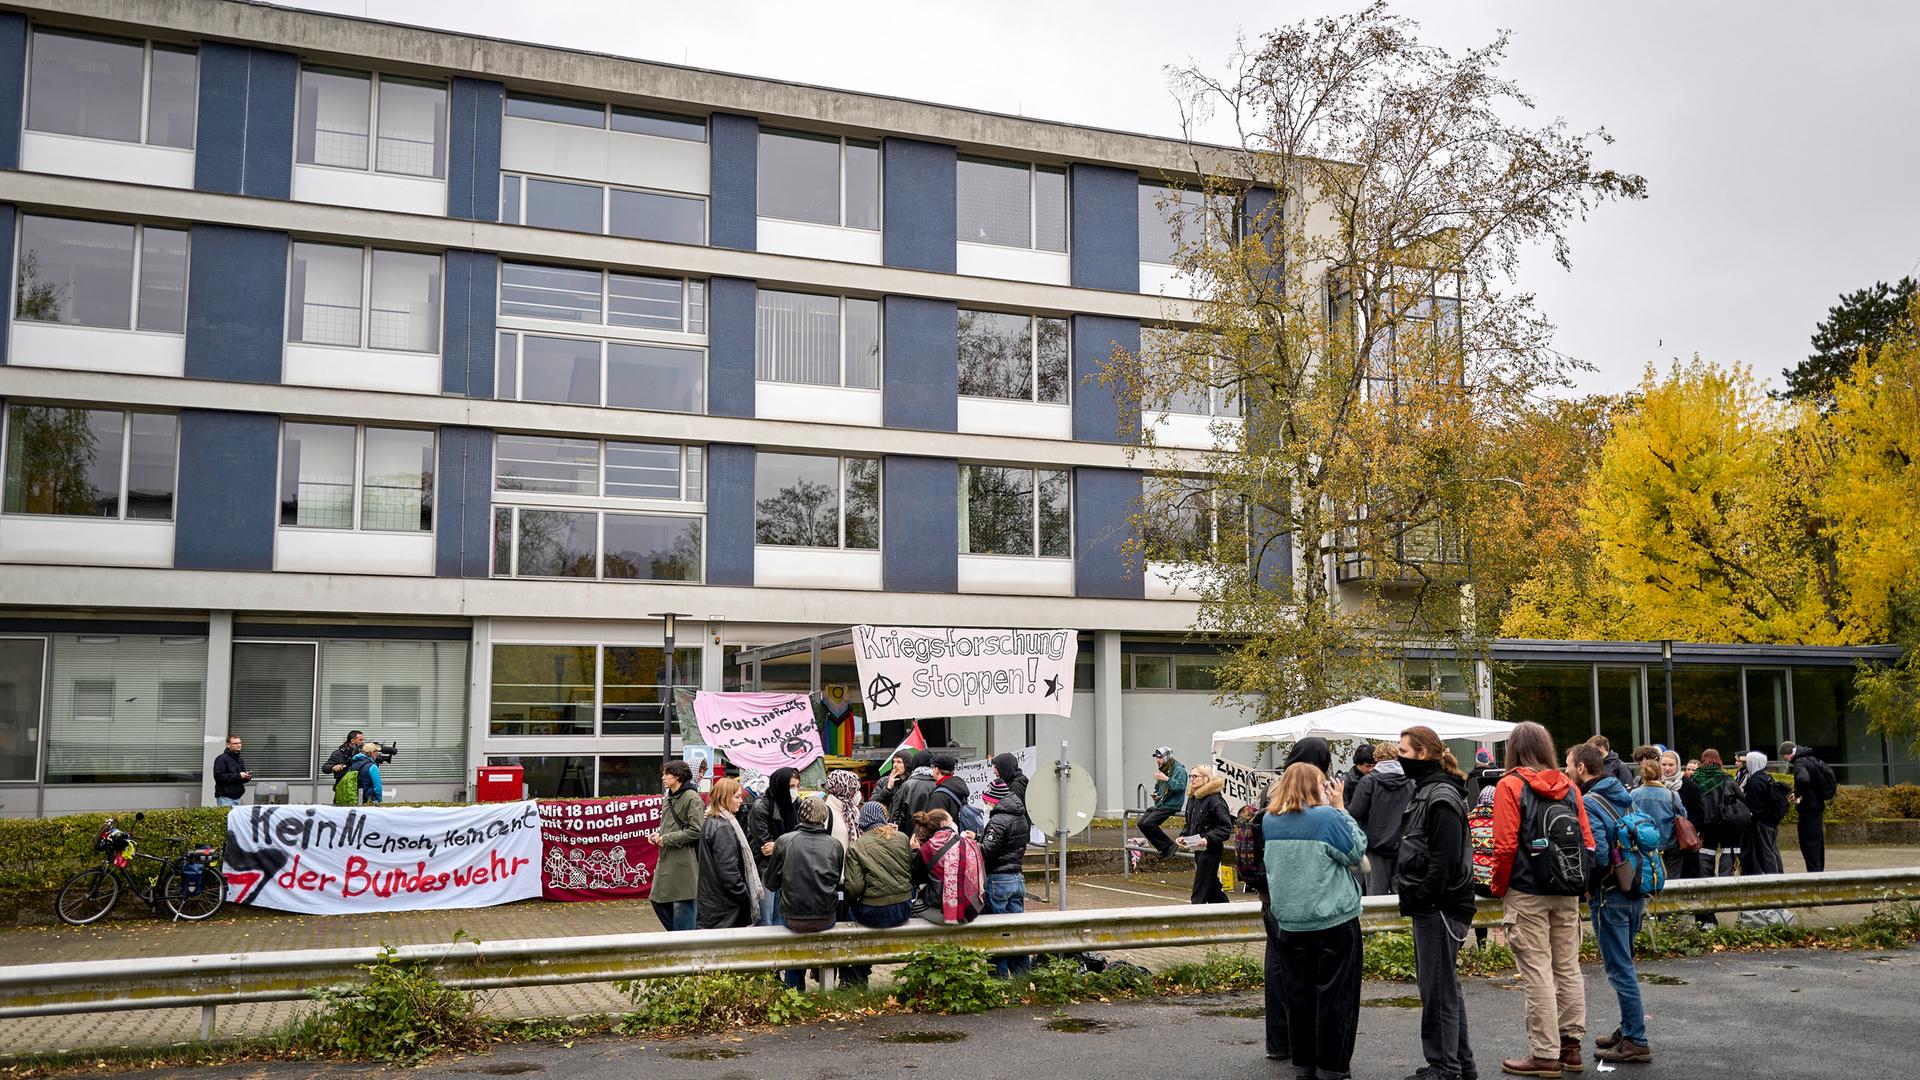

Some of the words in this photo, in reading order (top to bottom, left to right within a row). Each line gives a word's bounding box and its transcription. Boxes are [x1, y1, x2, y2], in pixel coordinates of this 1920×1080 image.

[859, 627, 1067, 663] Kriegsforschung
[539, 804, 563, 817] Mit
[565, 804, 582, 817] 18
[585, 805, 603, 816] an
[605, 800, 628, 813] die
[630, 796, 665, 809] Fron
[250, 806, 338, 850] Kein
[486, 805, 537, 839] Cent
[540, 818, 563, 829] mit
[564, 819, 584, 831] 70
[586, 815, 623, 830] noch
[625, 813, 648, 825] am
[543, 831, 569, 843] Streik
[570, 835, 601, 845] gegen
[601, 828, 651, 844] Regierung
[278, 854, 337, 892] der
[341, 849, 529, 898] Bundeswehr
